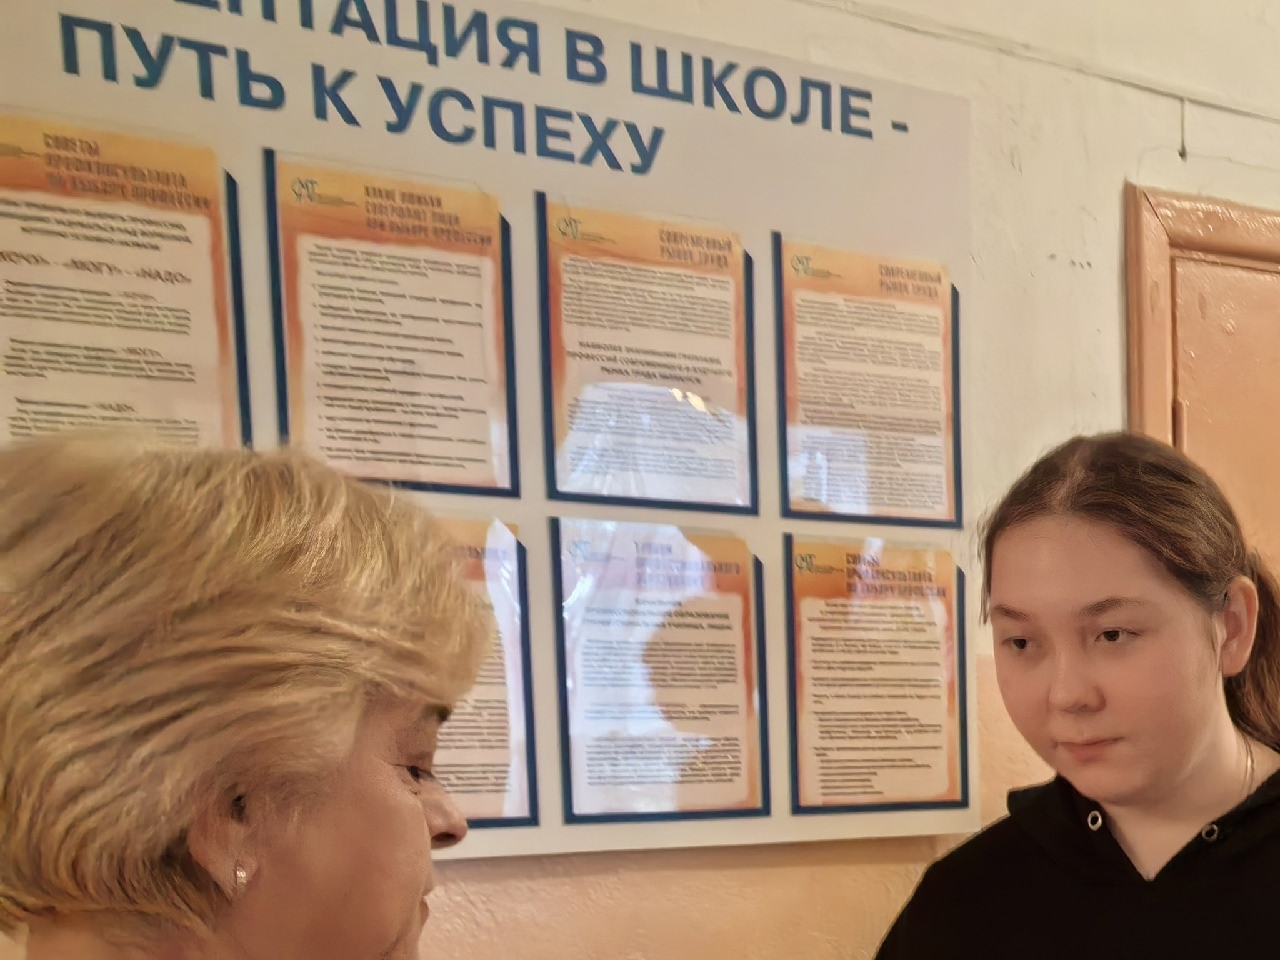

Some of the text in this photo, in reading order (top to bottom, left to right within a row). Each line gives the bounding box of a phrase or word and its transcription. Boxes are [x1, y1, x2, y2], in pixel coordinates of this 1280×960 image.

[58, 13, 665, 176] ПУТЬ К УСПЕХУ
[174, 0, 541, 76] АЦИЯ
[565, 28, 607, 86] В
[629, 40, 874, 140] ШКОЛЕ
